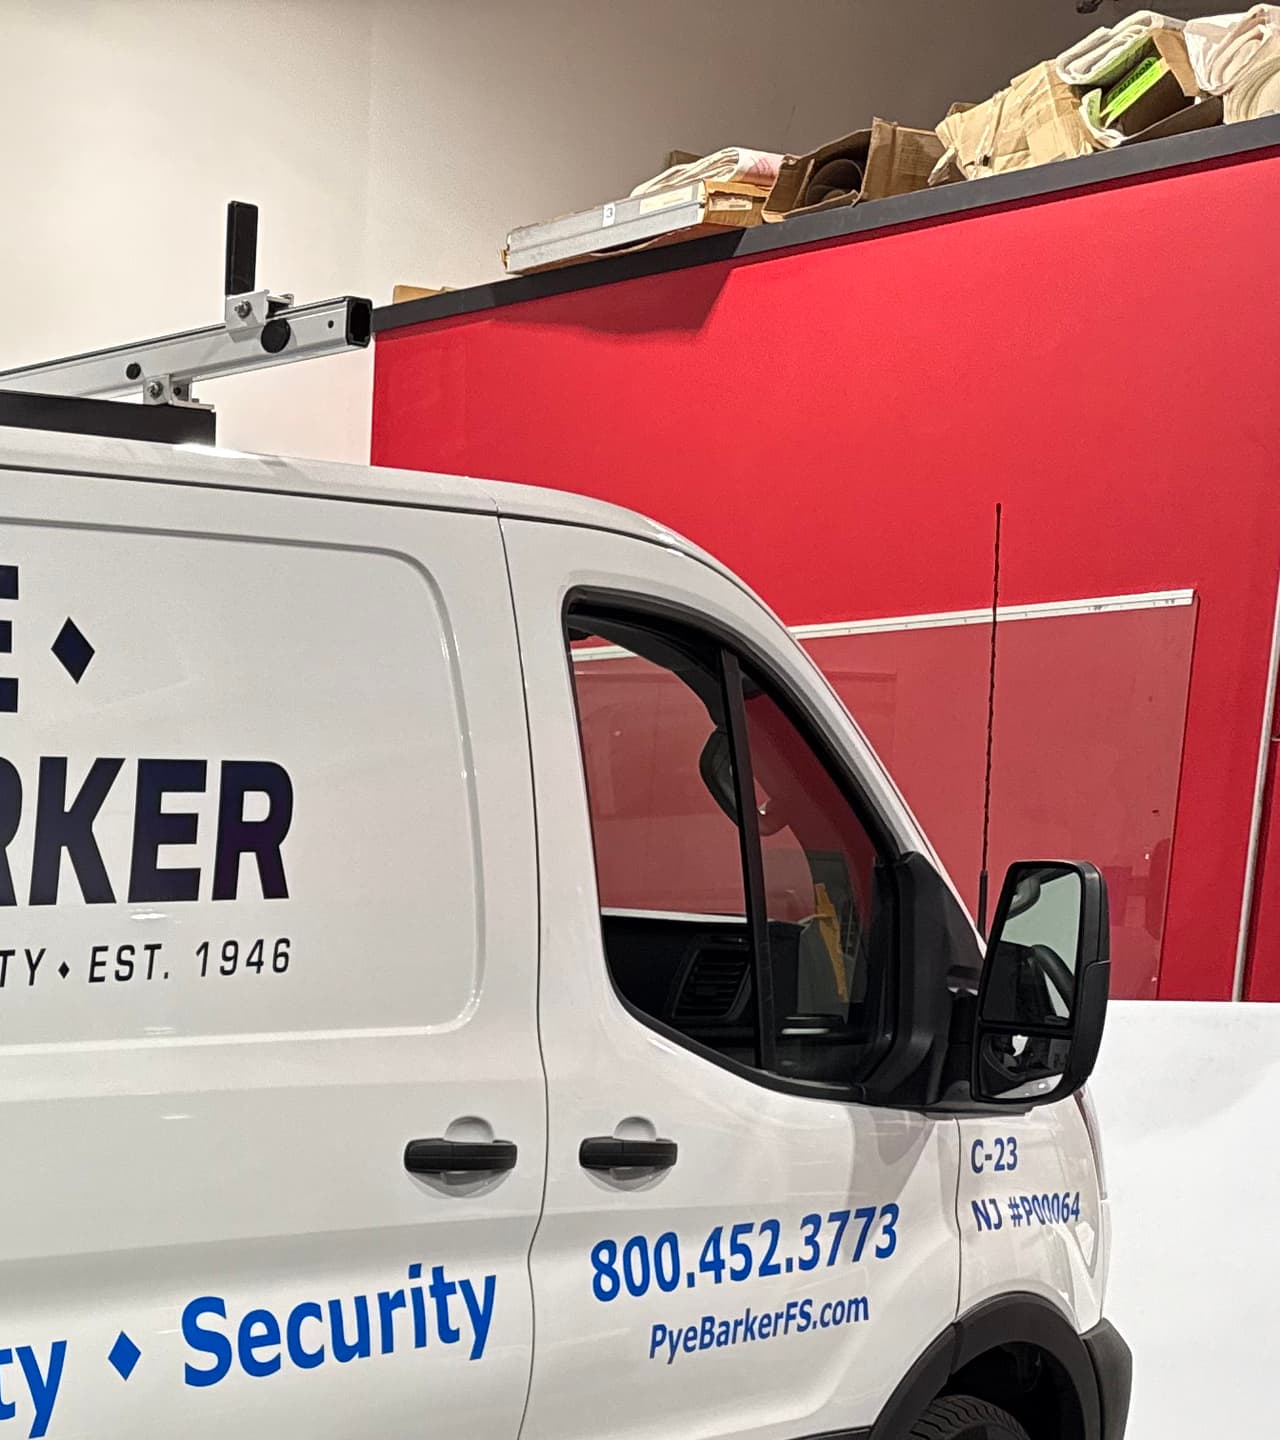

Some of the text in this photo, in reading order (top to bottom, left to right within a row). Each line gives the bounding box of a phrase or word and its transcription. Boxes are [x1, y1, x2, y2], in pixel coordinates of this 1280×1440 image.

[87, 943, 171, 984] EST.
[194, 937, 292, 978] 1946
[971, 1136, 1018, 1174] C-23
[971, 1191, 1081, 1233] NJ #P00064
[589, 1202, 901, 1303] 800.452.3773
[180, 1262, 498, 1388] Security
[648, 1295, 870, 1366] PyeBarkerFS.com
